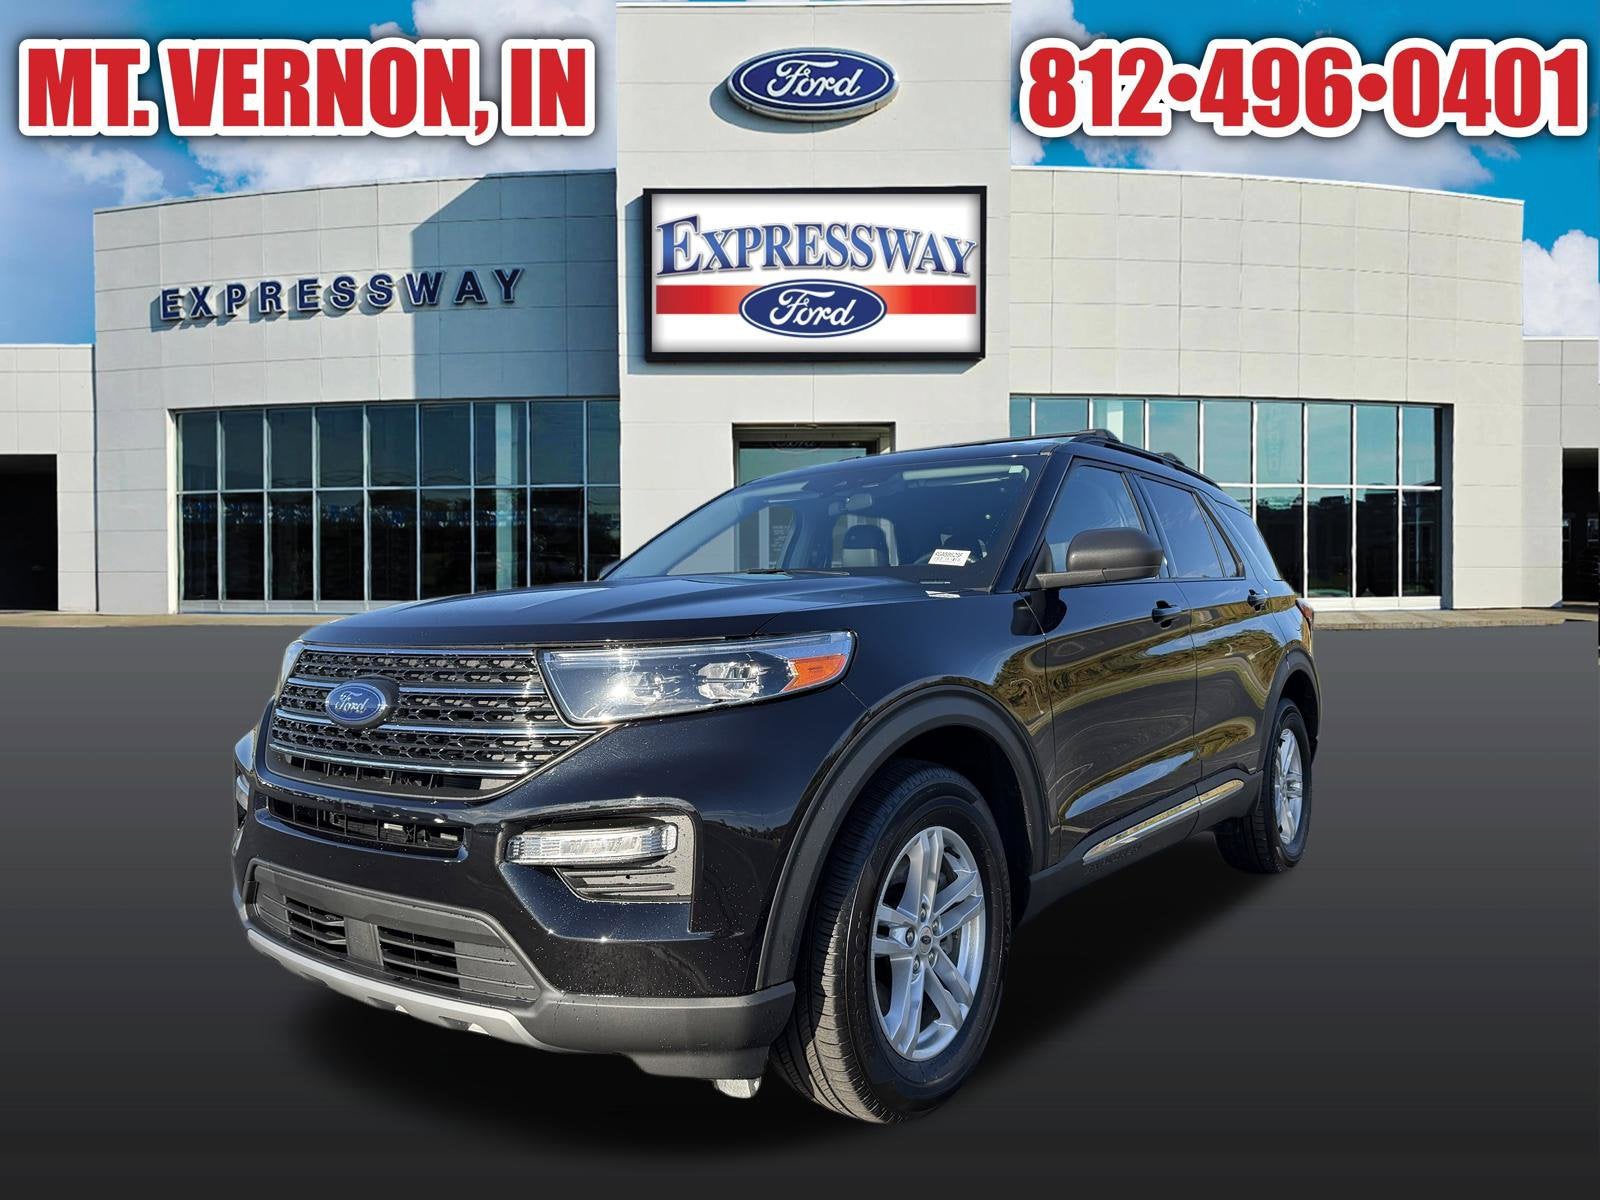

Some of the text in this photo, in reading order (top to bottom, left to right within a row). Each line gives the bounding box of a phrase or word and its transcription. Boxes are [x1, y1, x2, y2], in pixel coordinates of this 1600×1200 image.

[766, 59, 863, 98] Ford
[655, 214, 977, 278] EXPRESSWAY
[159, 267, 526, 322] EXPRESSWAY
[769, 288, 857, 327] Ford
[334, 690, 370, 714] Ford
